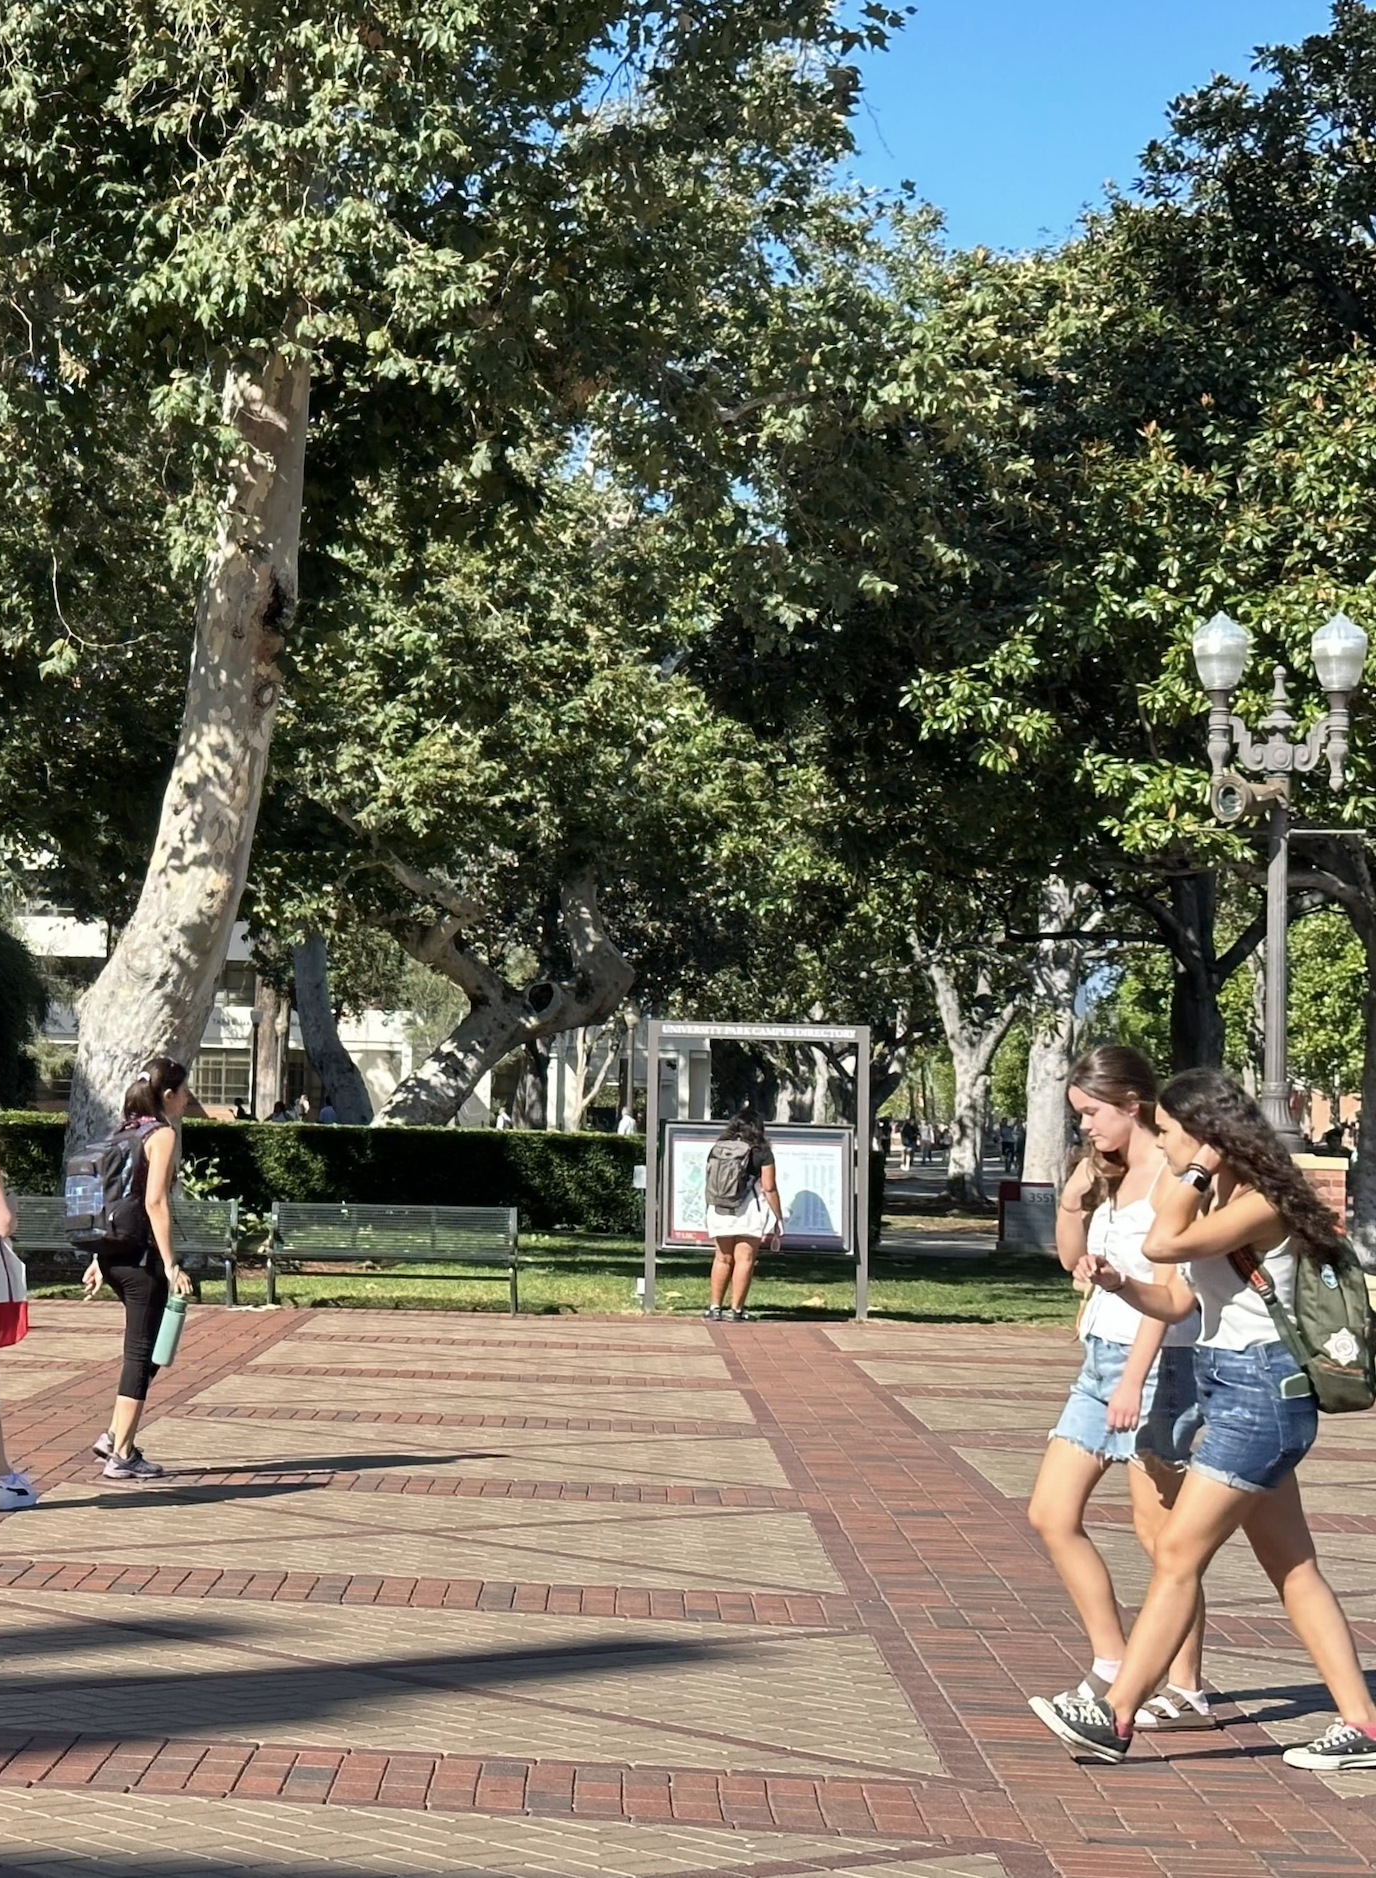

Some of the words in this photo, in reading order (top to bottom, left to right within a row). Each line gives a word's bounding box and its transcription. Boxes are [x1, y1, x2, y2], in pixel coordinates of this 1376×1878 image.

[662, 1024, 722, 1035] UNIVERSITY
[724, 1026, 751, 1035] PARK
[751, 1026, 795, 1037] CAMPUS
[795, 1027, 856, 1039] DIRECTORY
